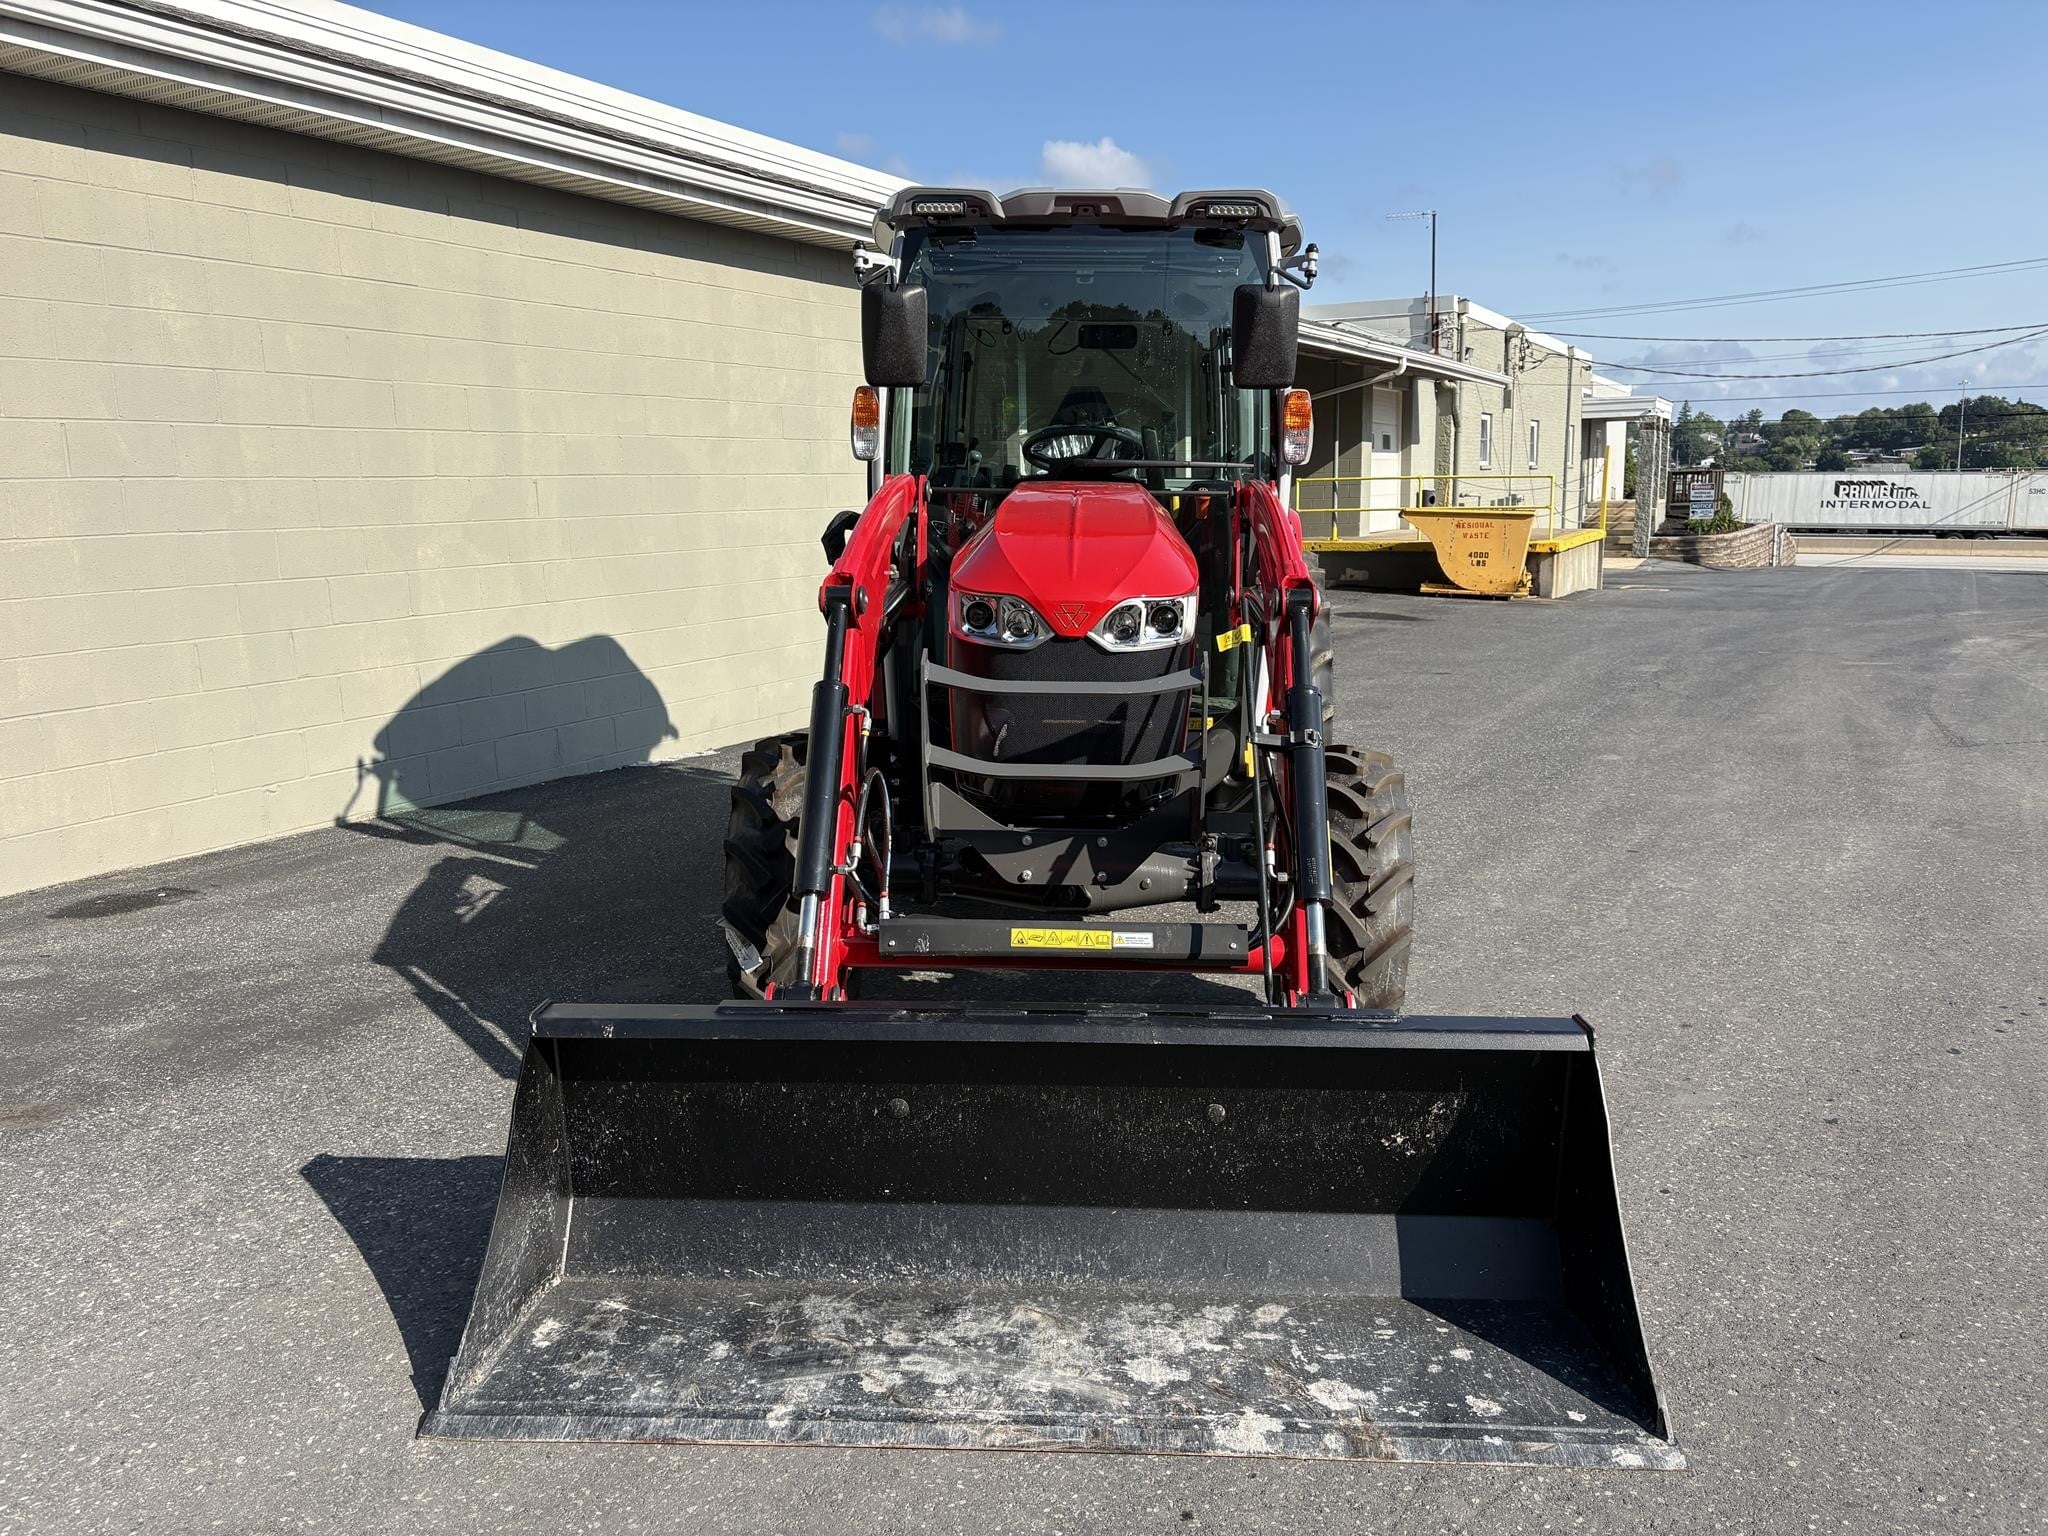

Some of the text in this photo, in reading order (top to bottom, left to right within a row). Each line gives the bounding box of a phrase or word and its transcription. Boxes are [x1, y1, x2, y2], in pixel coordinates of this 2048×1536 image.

[1834, 480, 1889, 499] PRIME
[1820, 500, 1931, 509] INTERMODAL
[1456, 521, 1495, 529] RESIDUAL
[1468, 551, 1489, 559] 4000
